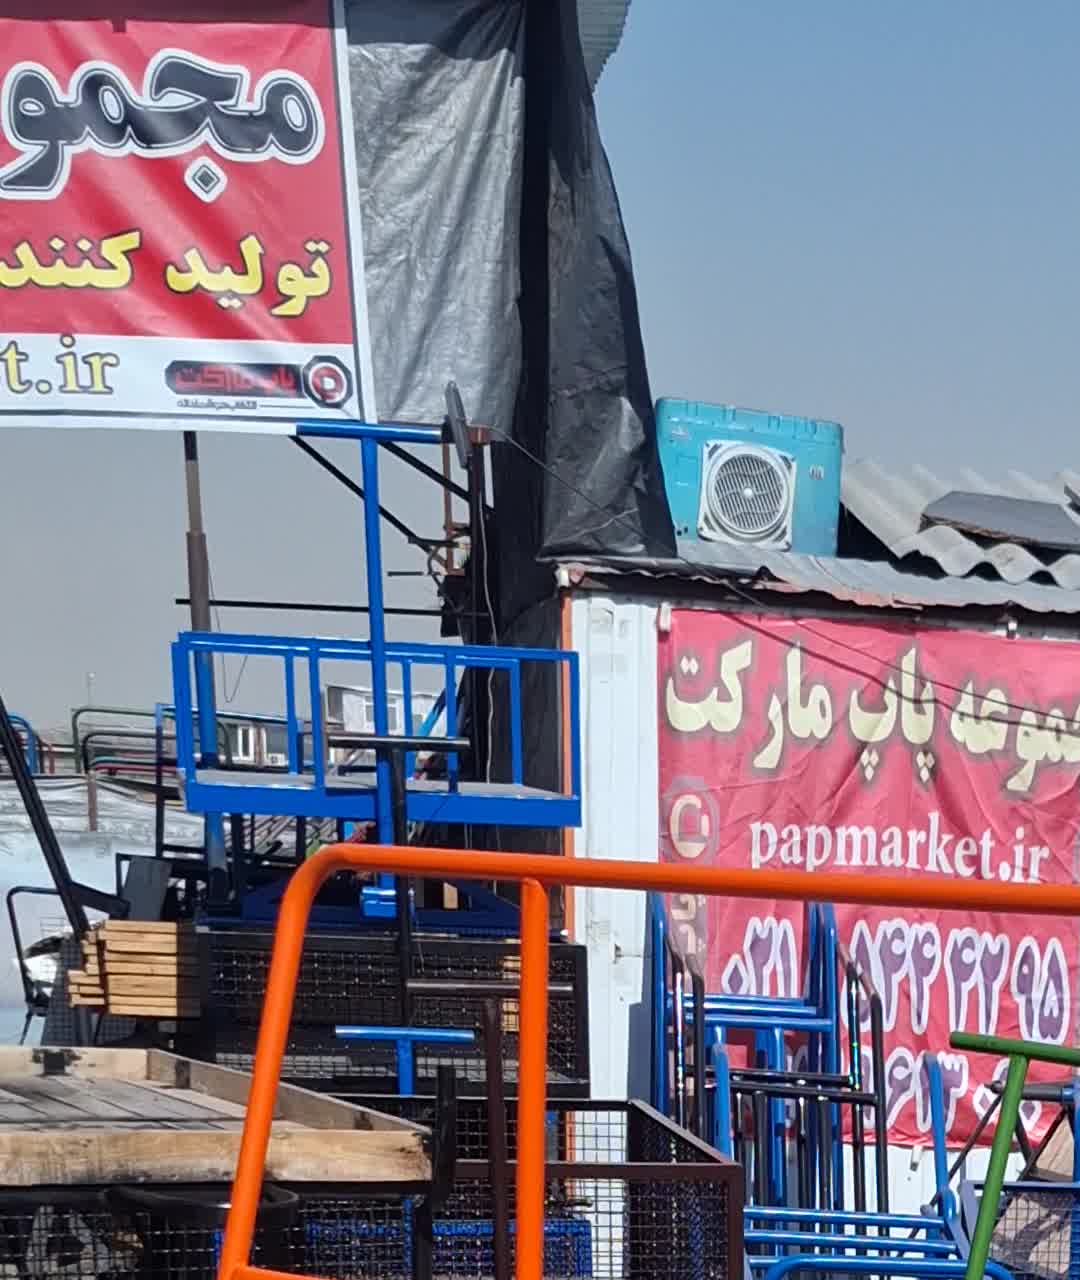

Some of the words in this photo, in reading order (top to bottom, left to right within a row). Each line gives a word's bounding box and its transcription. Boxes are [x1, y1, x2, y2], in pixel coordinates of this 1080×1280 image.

[165, 235, 332, 316] تولید
[848, 647, 935, 784] پاپ
[749, 810, 1050, 886] papmarket.ir
